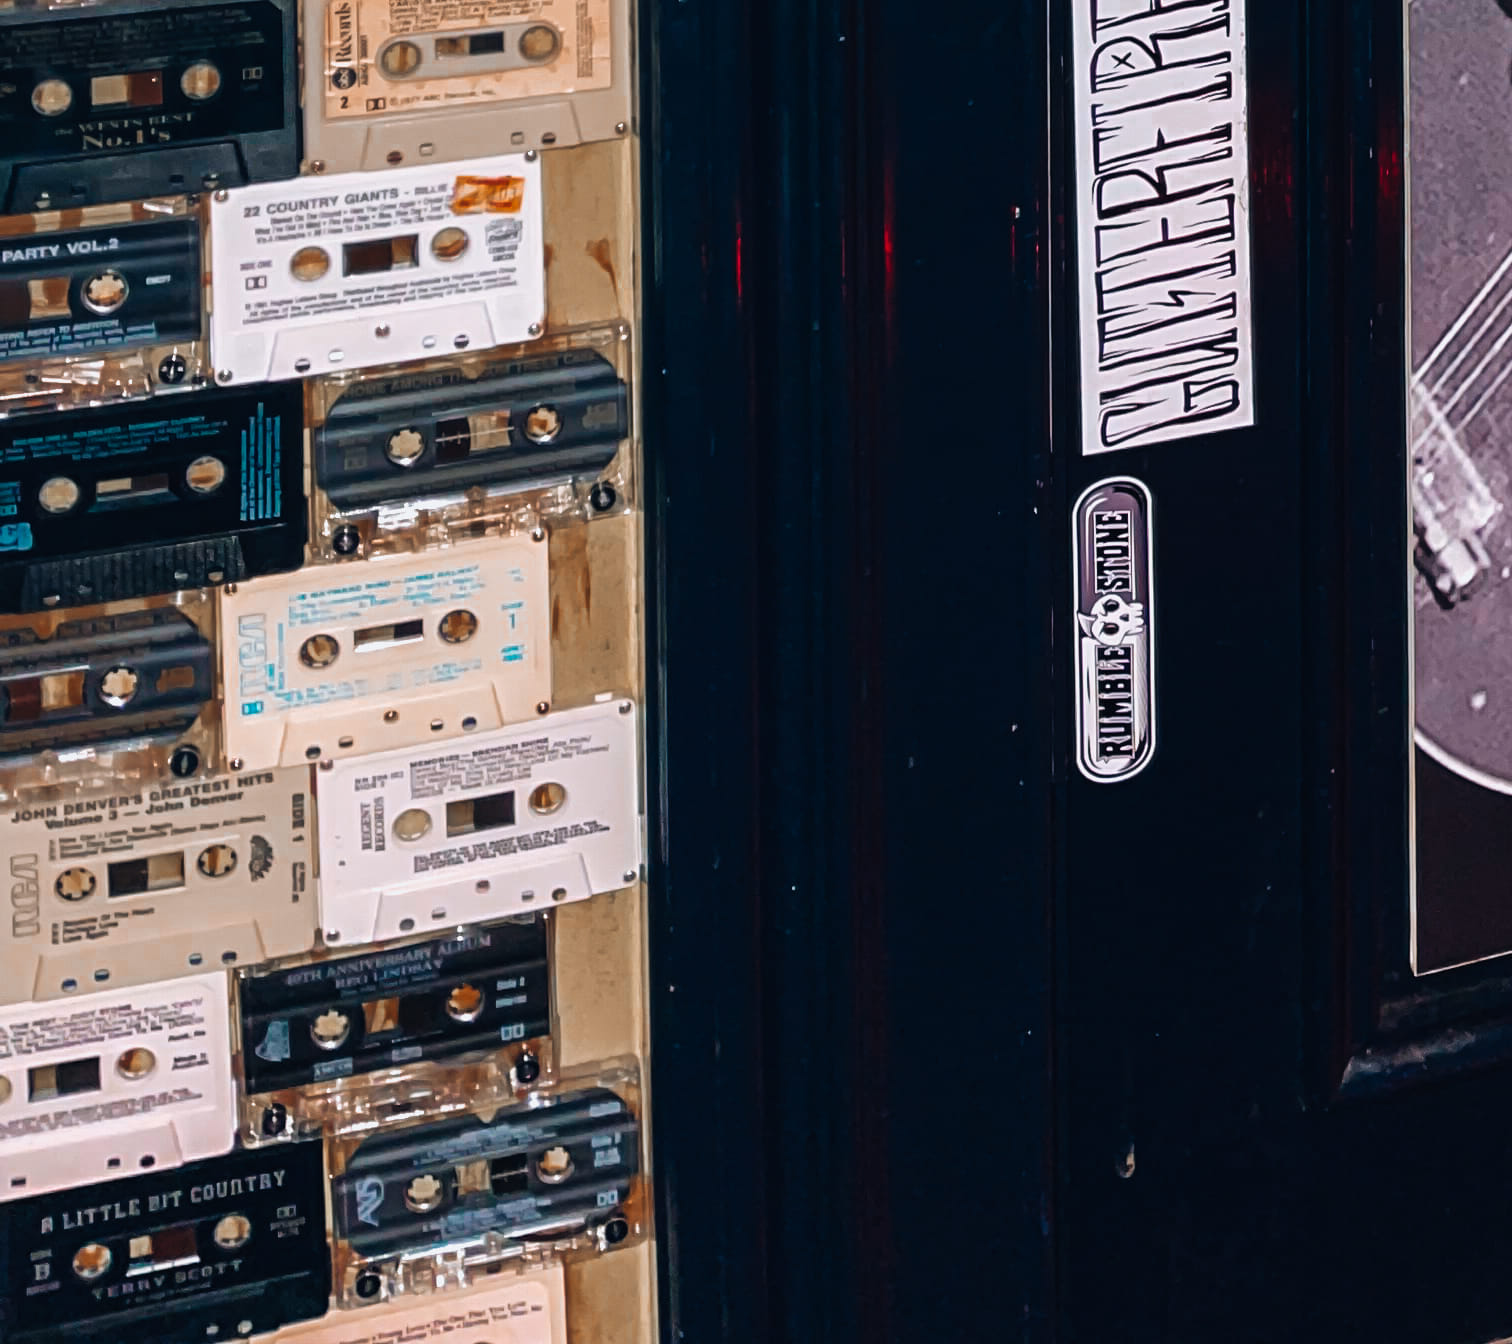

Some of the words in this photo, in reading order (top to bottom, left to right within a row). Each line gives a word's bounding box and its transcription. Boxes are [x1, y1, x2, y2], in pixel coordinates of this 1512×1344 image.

[334, 1, 352, 63] Records
[340, 95, 349, 109] 2
[243, 206, 261, 218] 22
[266, 195, 339, 216] COUNTRY
[344, 187, 399, 205] GIANTS
[2, 244, 60, 263] PARTY
[66, 237, 120, 255] VOL.2
[1094, 511, 1132, 594] STONE
[238, 613, 267, 697] RCA
[1095, 645, 1134, 764] RUMBLE
[11, 807, 57, 823] JOHN
[63, 796, 143, 819] DENVER'S
[149, 782, 230, 802] GREATEST
[237, 772, 275, 788] HITS
[45, 813, 103, 830] Volume
[109, 808, 118, 820] 3
[145, 800, 185, 816] John
[190, 791, 244, 808] Denver
[292, 793, 305, 829] SIDE
[360, 802, 373, 851] REGENT
[374, 796, 386, 852] RECORDS
[10, 853, 40, 938] RCA
[327, 947, 432, 979] ANNIVERSARY
[438, 935, 492, 956] ALBUM
[41, 1216, 53, 1234] A
[62, 1198, 141, 1230] LITTLE
[148, 1190, 183, 1212] BIT
[190, 1169, 286, 1204] COUNTRY
